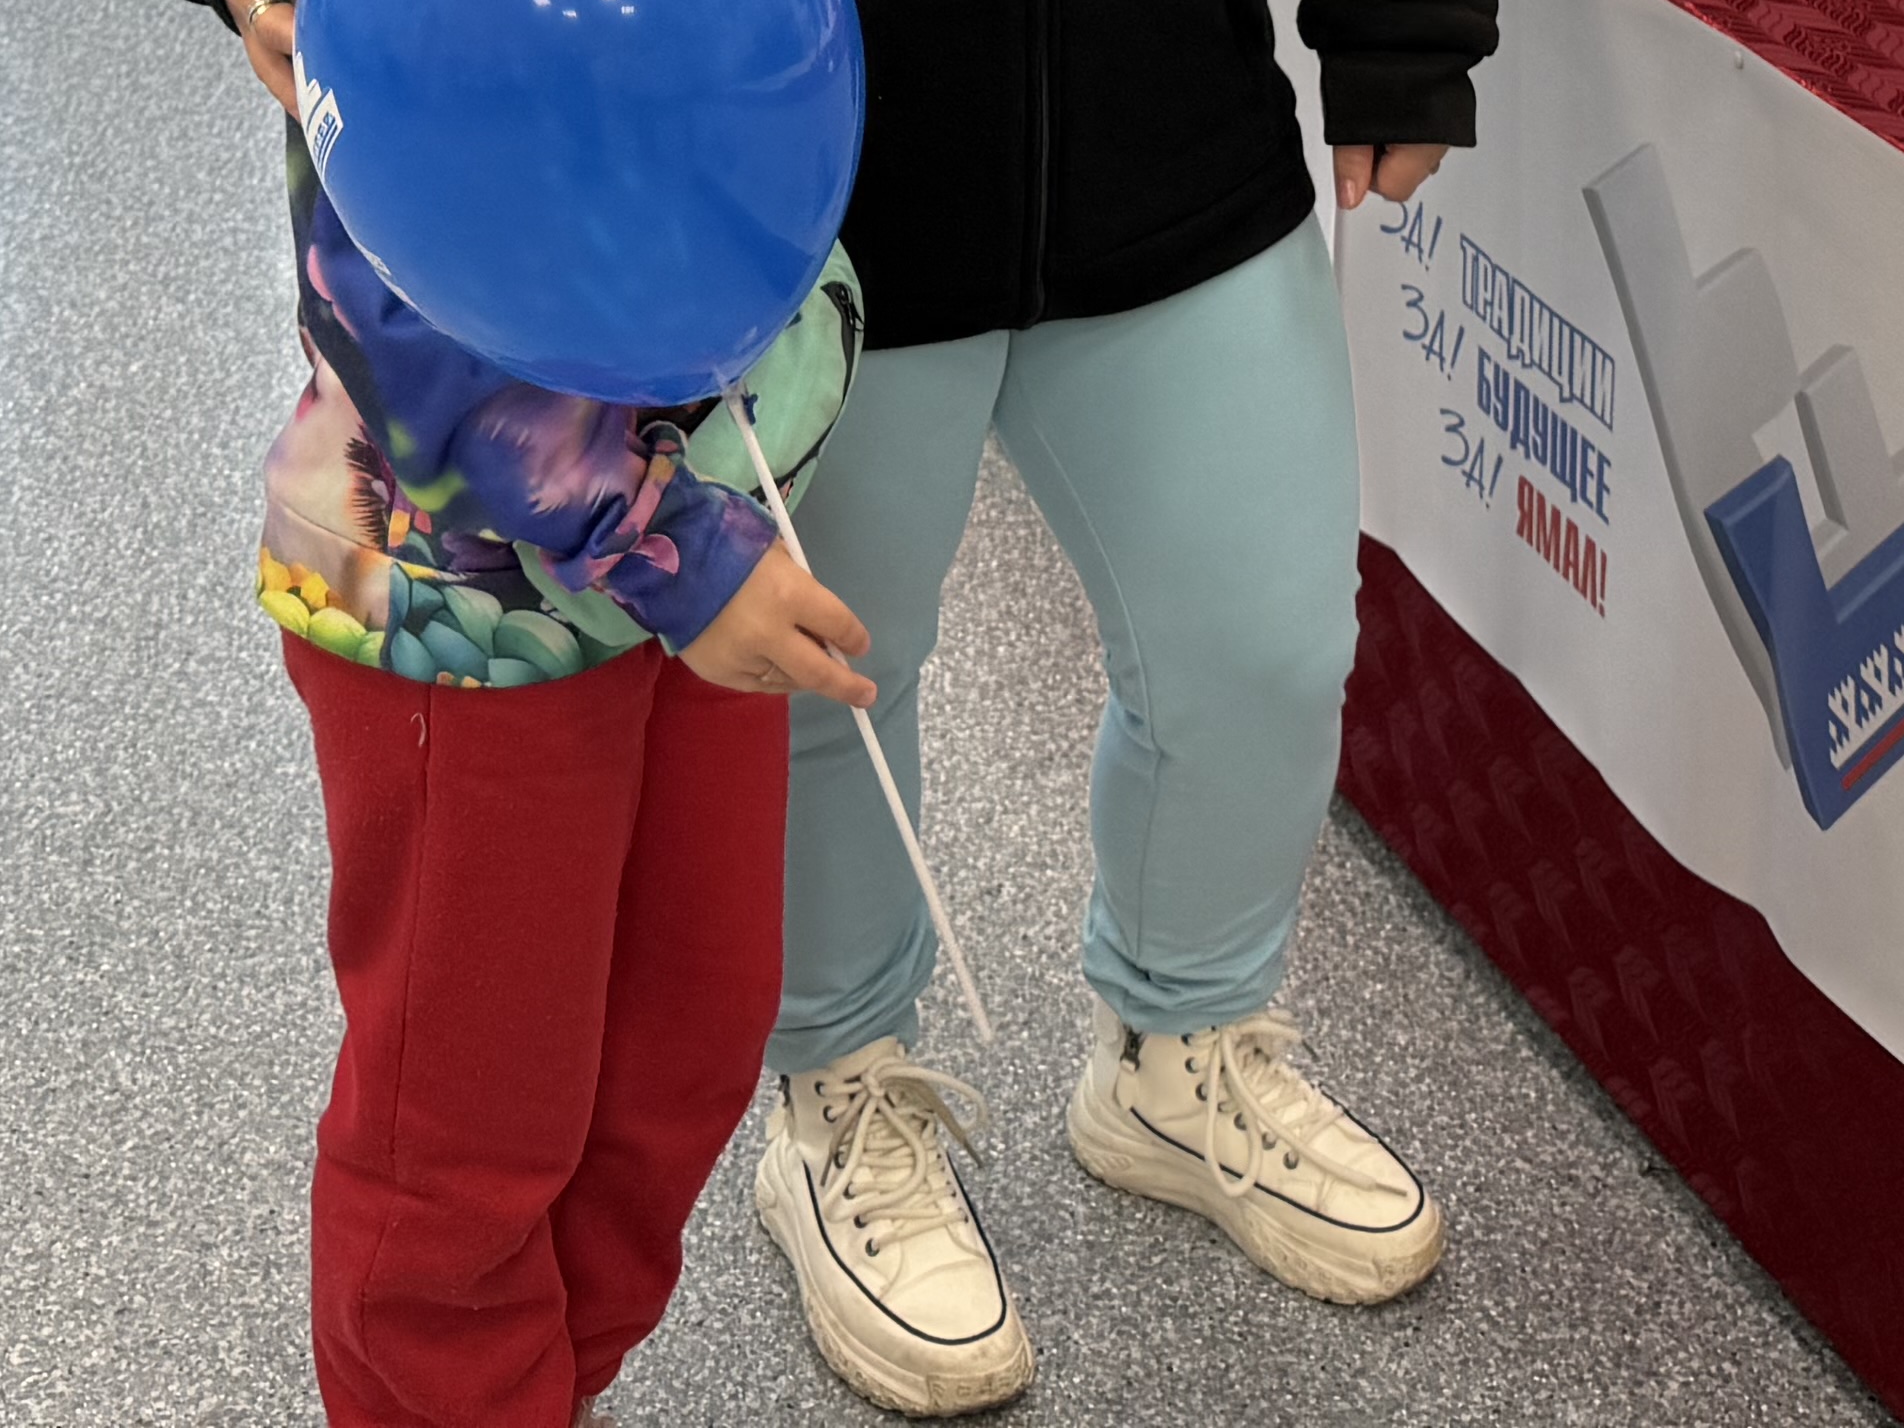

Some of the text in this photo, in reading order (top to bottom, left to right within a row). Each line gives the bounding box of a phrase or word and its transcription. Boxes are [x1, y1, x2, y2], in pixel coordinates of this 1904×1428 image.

[1401, 283, 1612, 526] ЗА! БУДУЩЕЕ
[1460, 233, 1615, 432] ТРАДИЦИИ
[1439, 407, 1608, 619] ЗА! ЯМАЛ!
